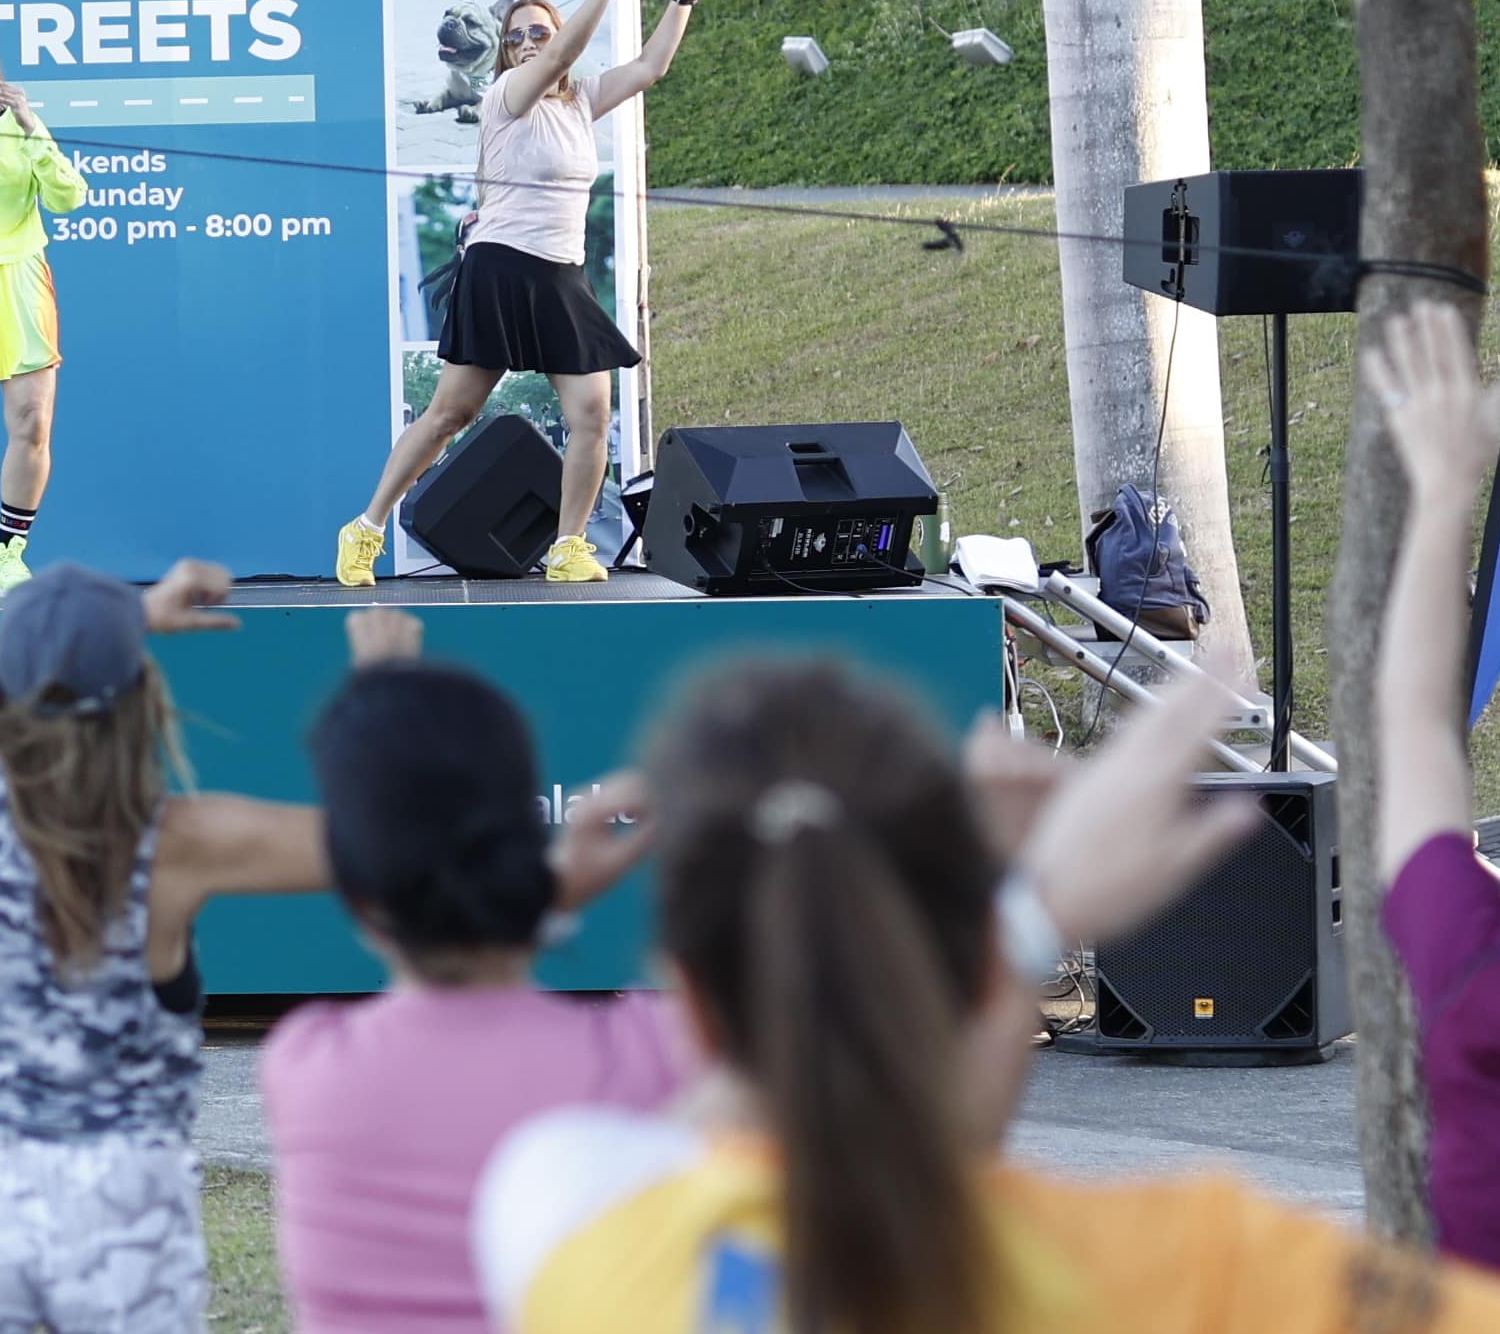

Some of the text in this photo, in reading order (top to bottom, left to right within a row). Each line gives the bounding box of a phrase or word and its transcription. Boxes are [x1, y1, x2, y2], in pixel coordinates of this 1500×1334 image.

[73, 149, 167, 176] kends
[84, 182, 184, 211] unday
[53, 217, 117, 242] 3:00
[127, 221, 177, 244] pm
[205, 214, 275, 239] 8:00
[281, 217, 331, 242] pm
